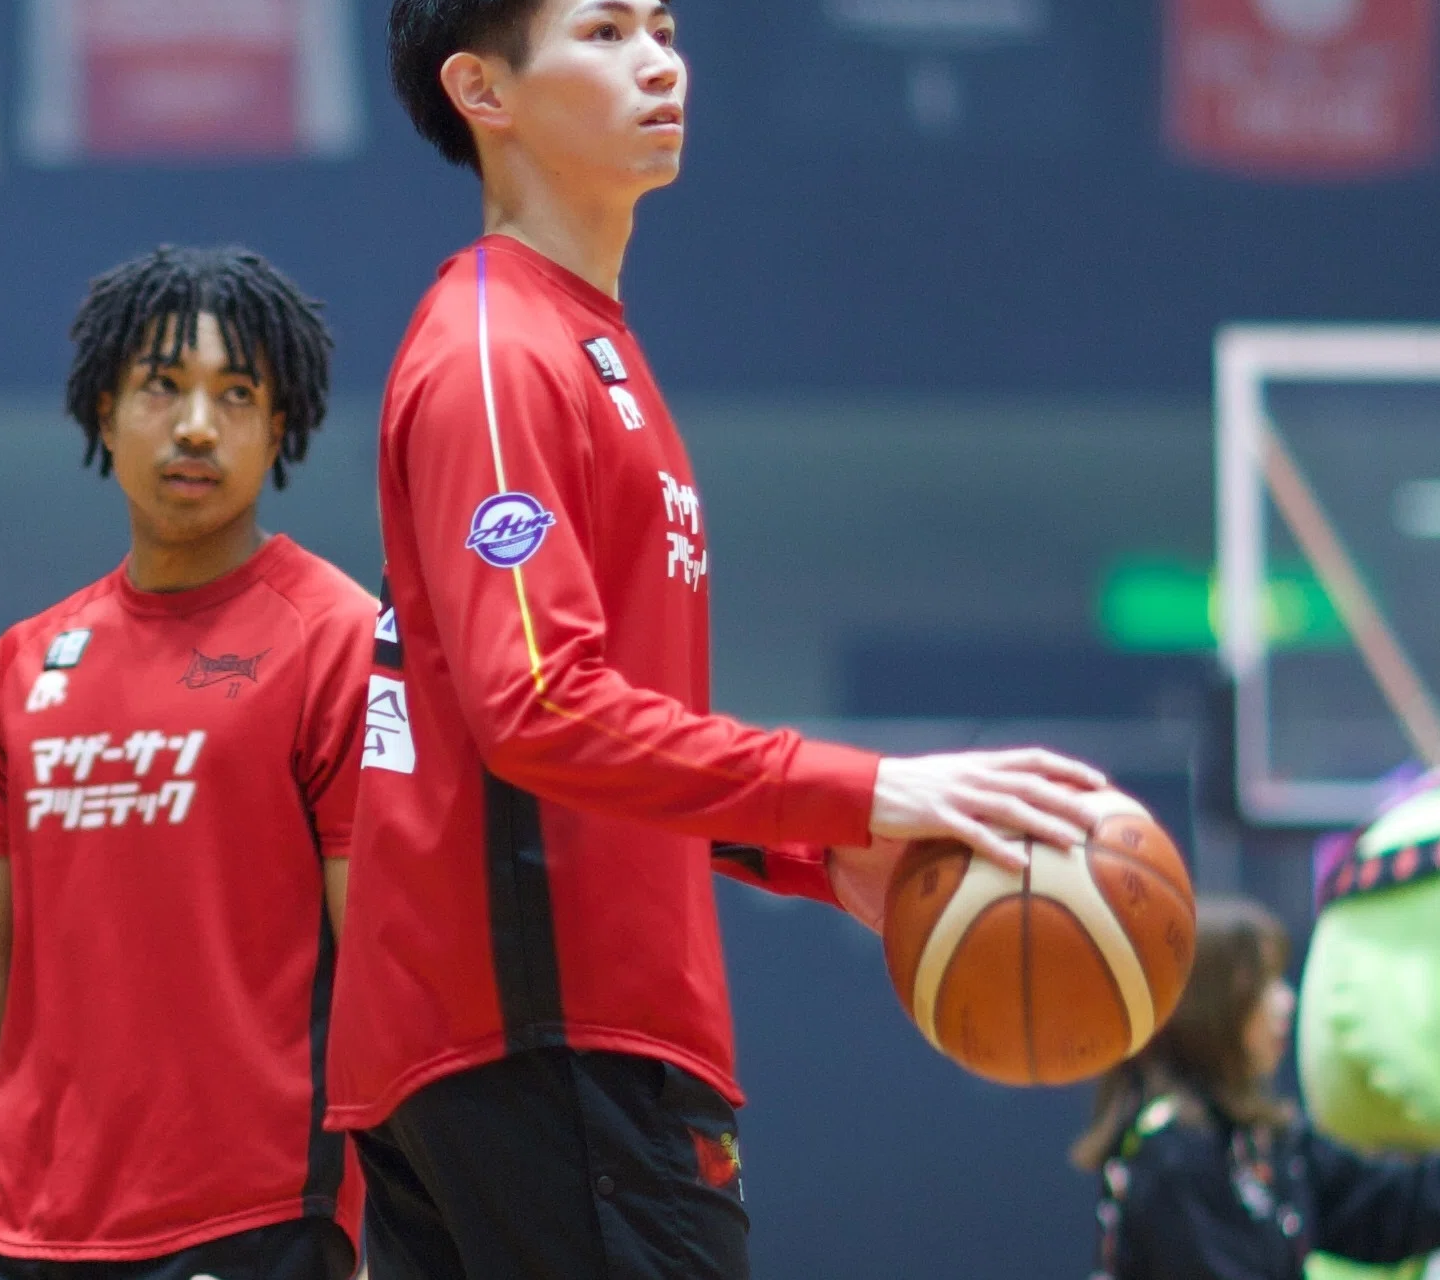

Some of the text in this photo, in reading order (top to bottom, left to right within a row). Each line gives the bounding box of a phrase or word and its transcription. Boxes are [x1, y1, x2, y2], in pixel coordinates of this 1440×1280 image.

[30, 729, 207, 784] マザーサン
